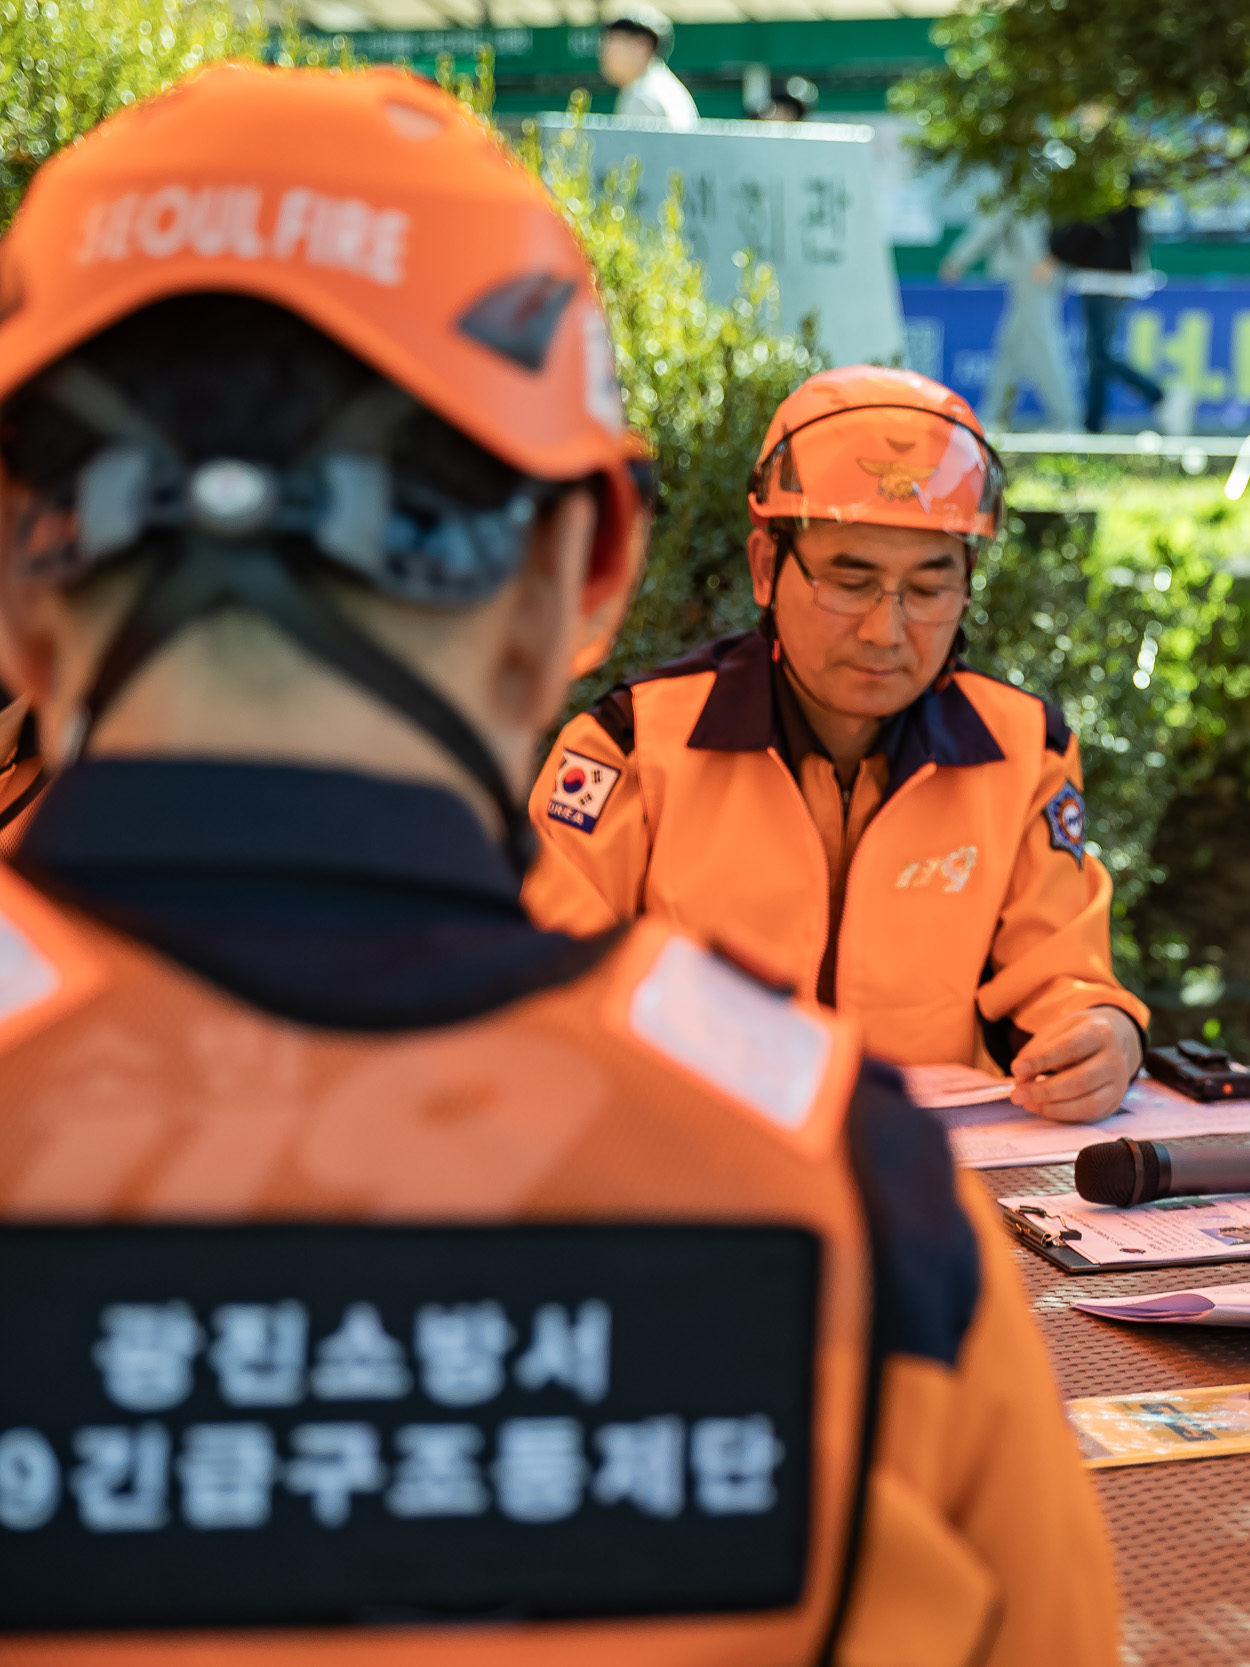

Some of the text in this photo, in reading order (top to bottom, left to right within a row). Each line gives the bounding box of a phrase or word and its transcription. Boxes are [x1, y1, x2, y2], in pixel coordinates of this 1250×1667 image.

[72, 183, 410, 288] SEOUL FIRE
[93, 1299, 612, 1410] 광진소방서
